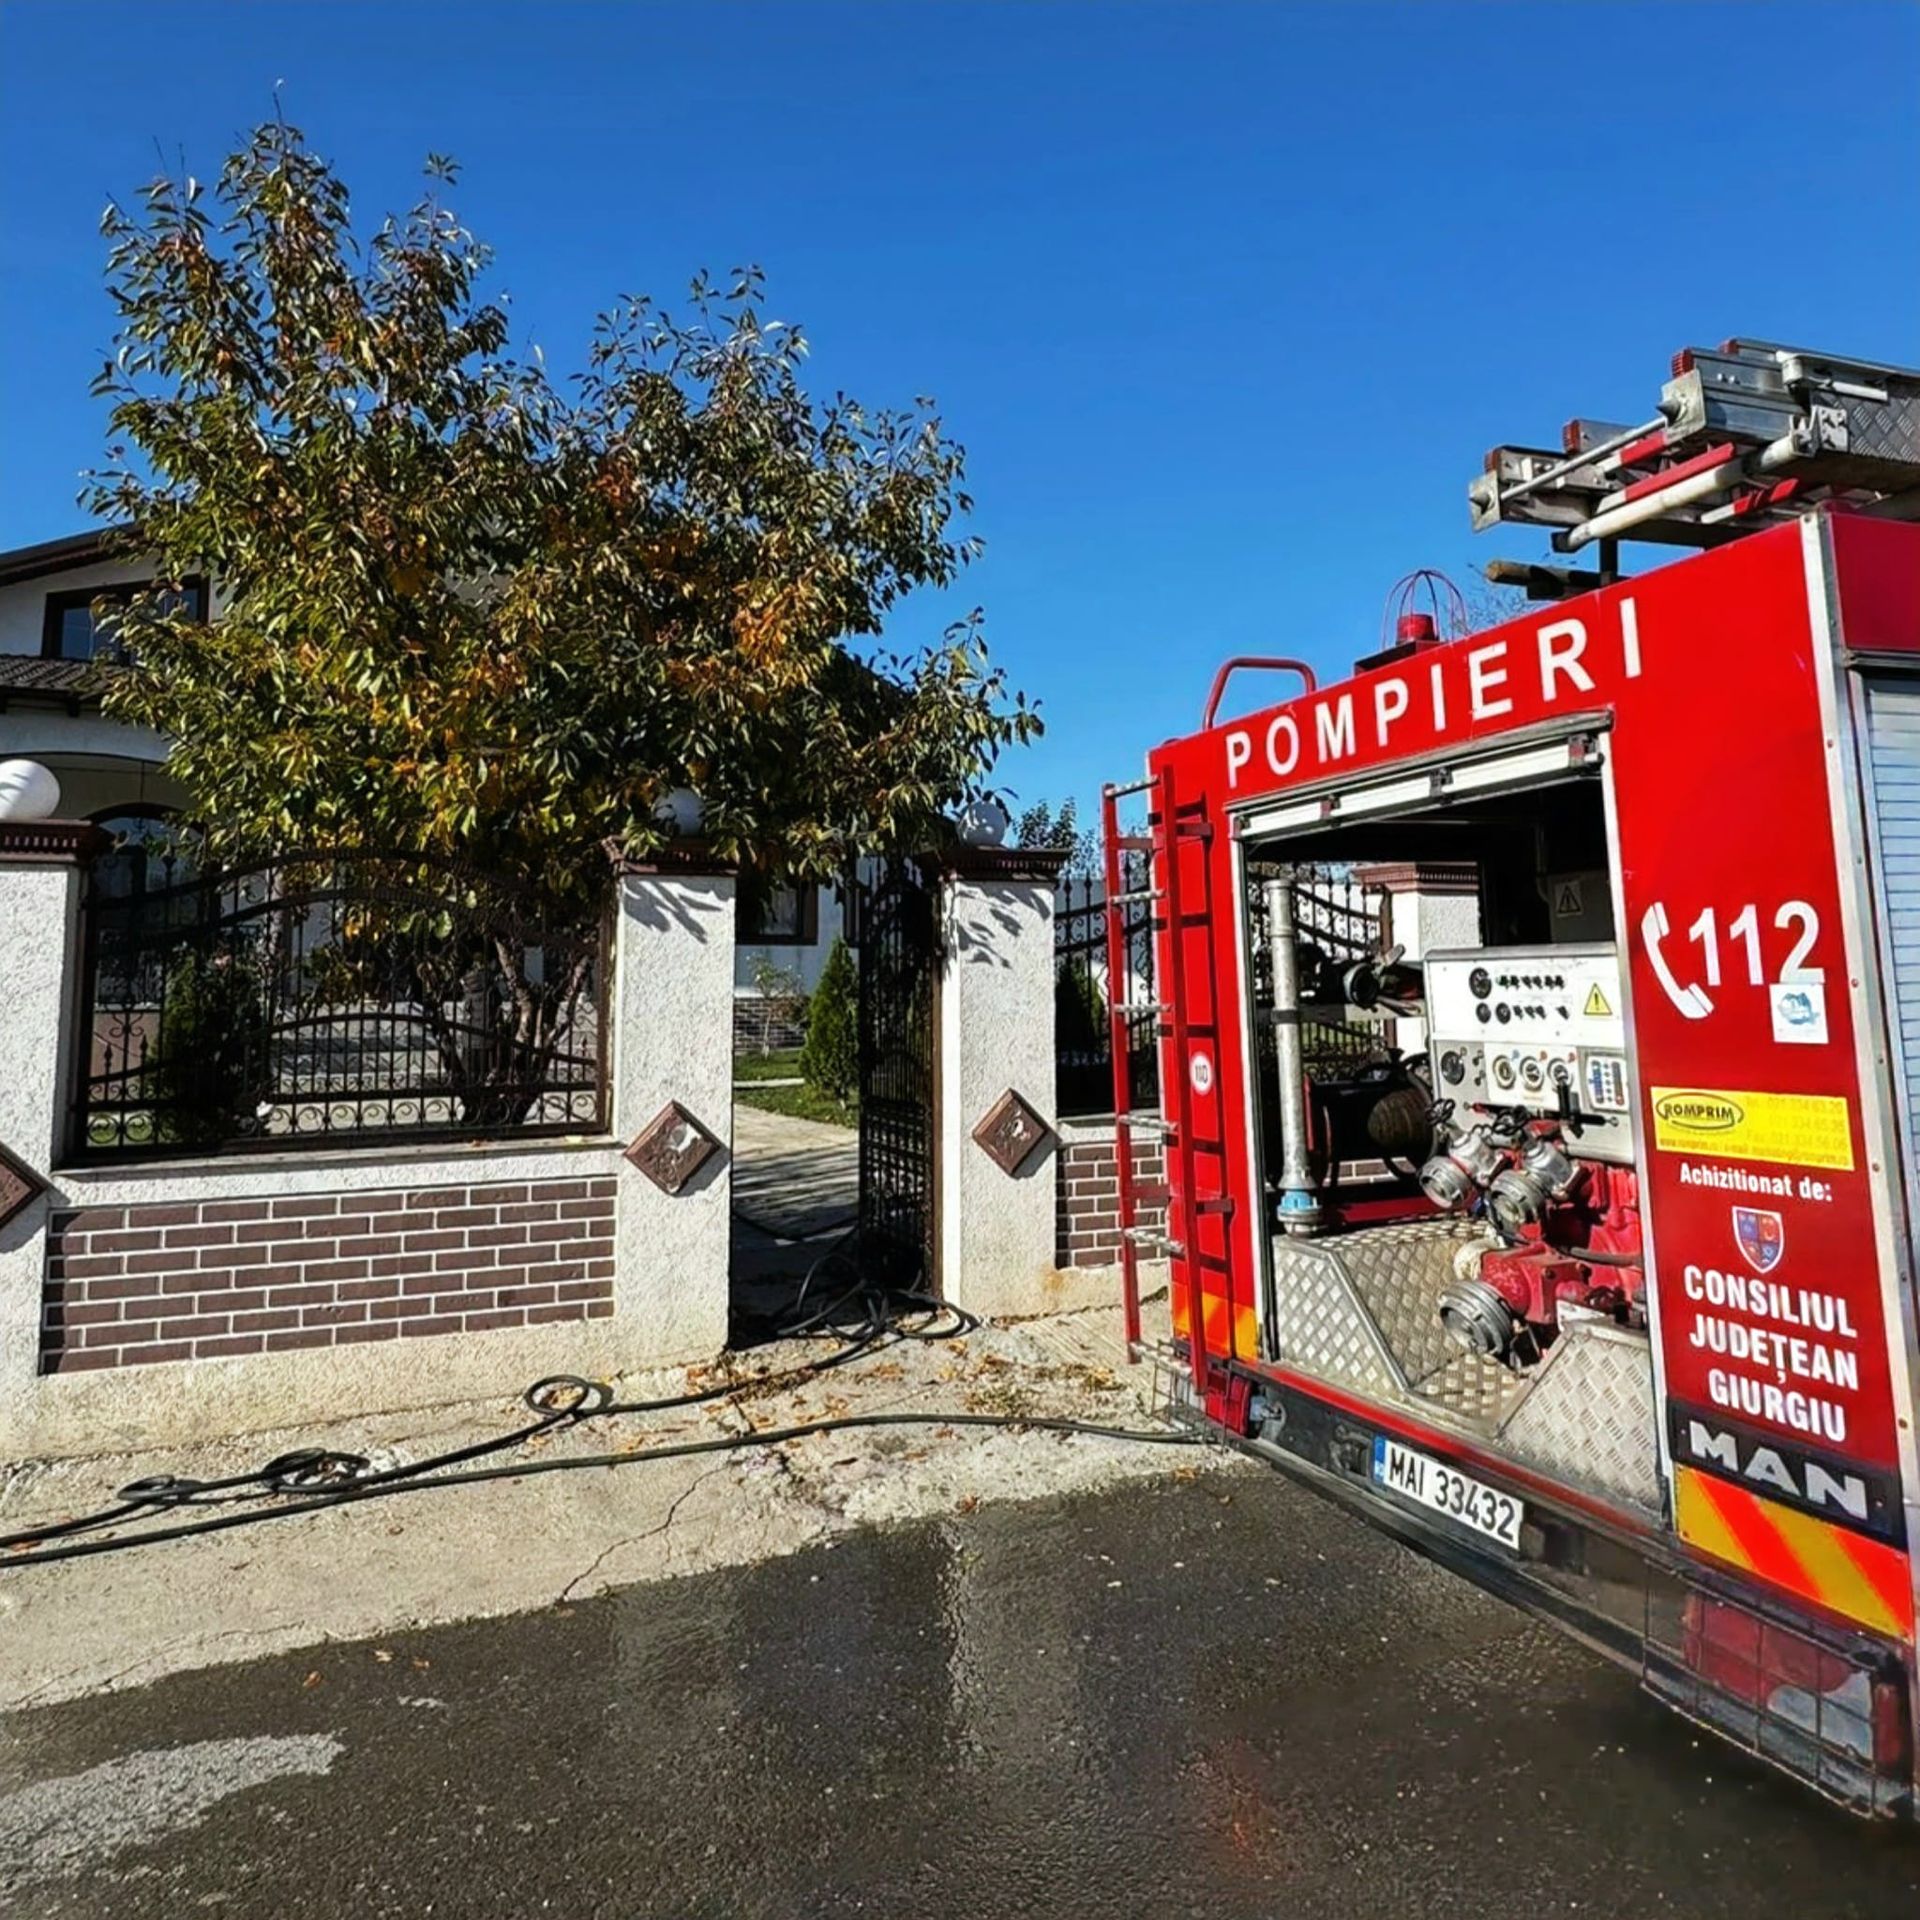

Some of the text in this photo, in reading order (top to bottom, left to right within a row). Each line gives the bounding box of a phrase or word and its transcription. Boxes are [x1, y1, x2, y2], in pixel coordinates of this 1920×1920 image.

[1225, 597, 1642, 789] POMPIERI
[1688, 900, 1826, 986] 112
[1664, 1103, 1735, 1122] ROMPRIM
[1680, 1162, 1833, 1202] Achizitionat de:
[1683, 1265, 1858, 1338] CONSILIUL
[1689, 1314, 1859, 1391] JUDEȚEAN
[1708, 1369, 1846, 1442] GIURGIU
[1389, 1448, 1515, 1542] MAI 33432
[1689, 1420, 1868, 1520] MAN
